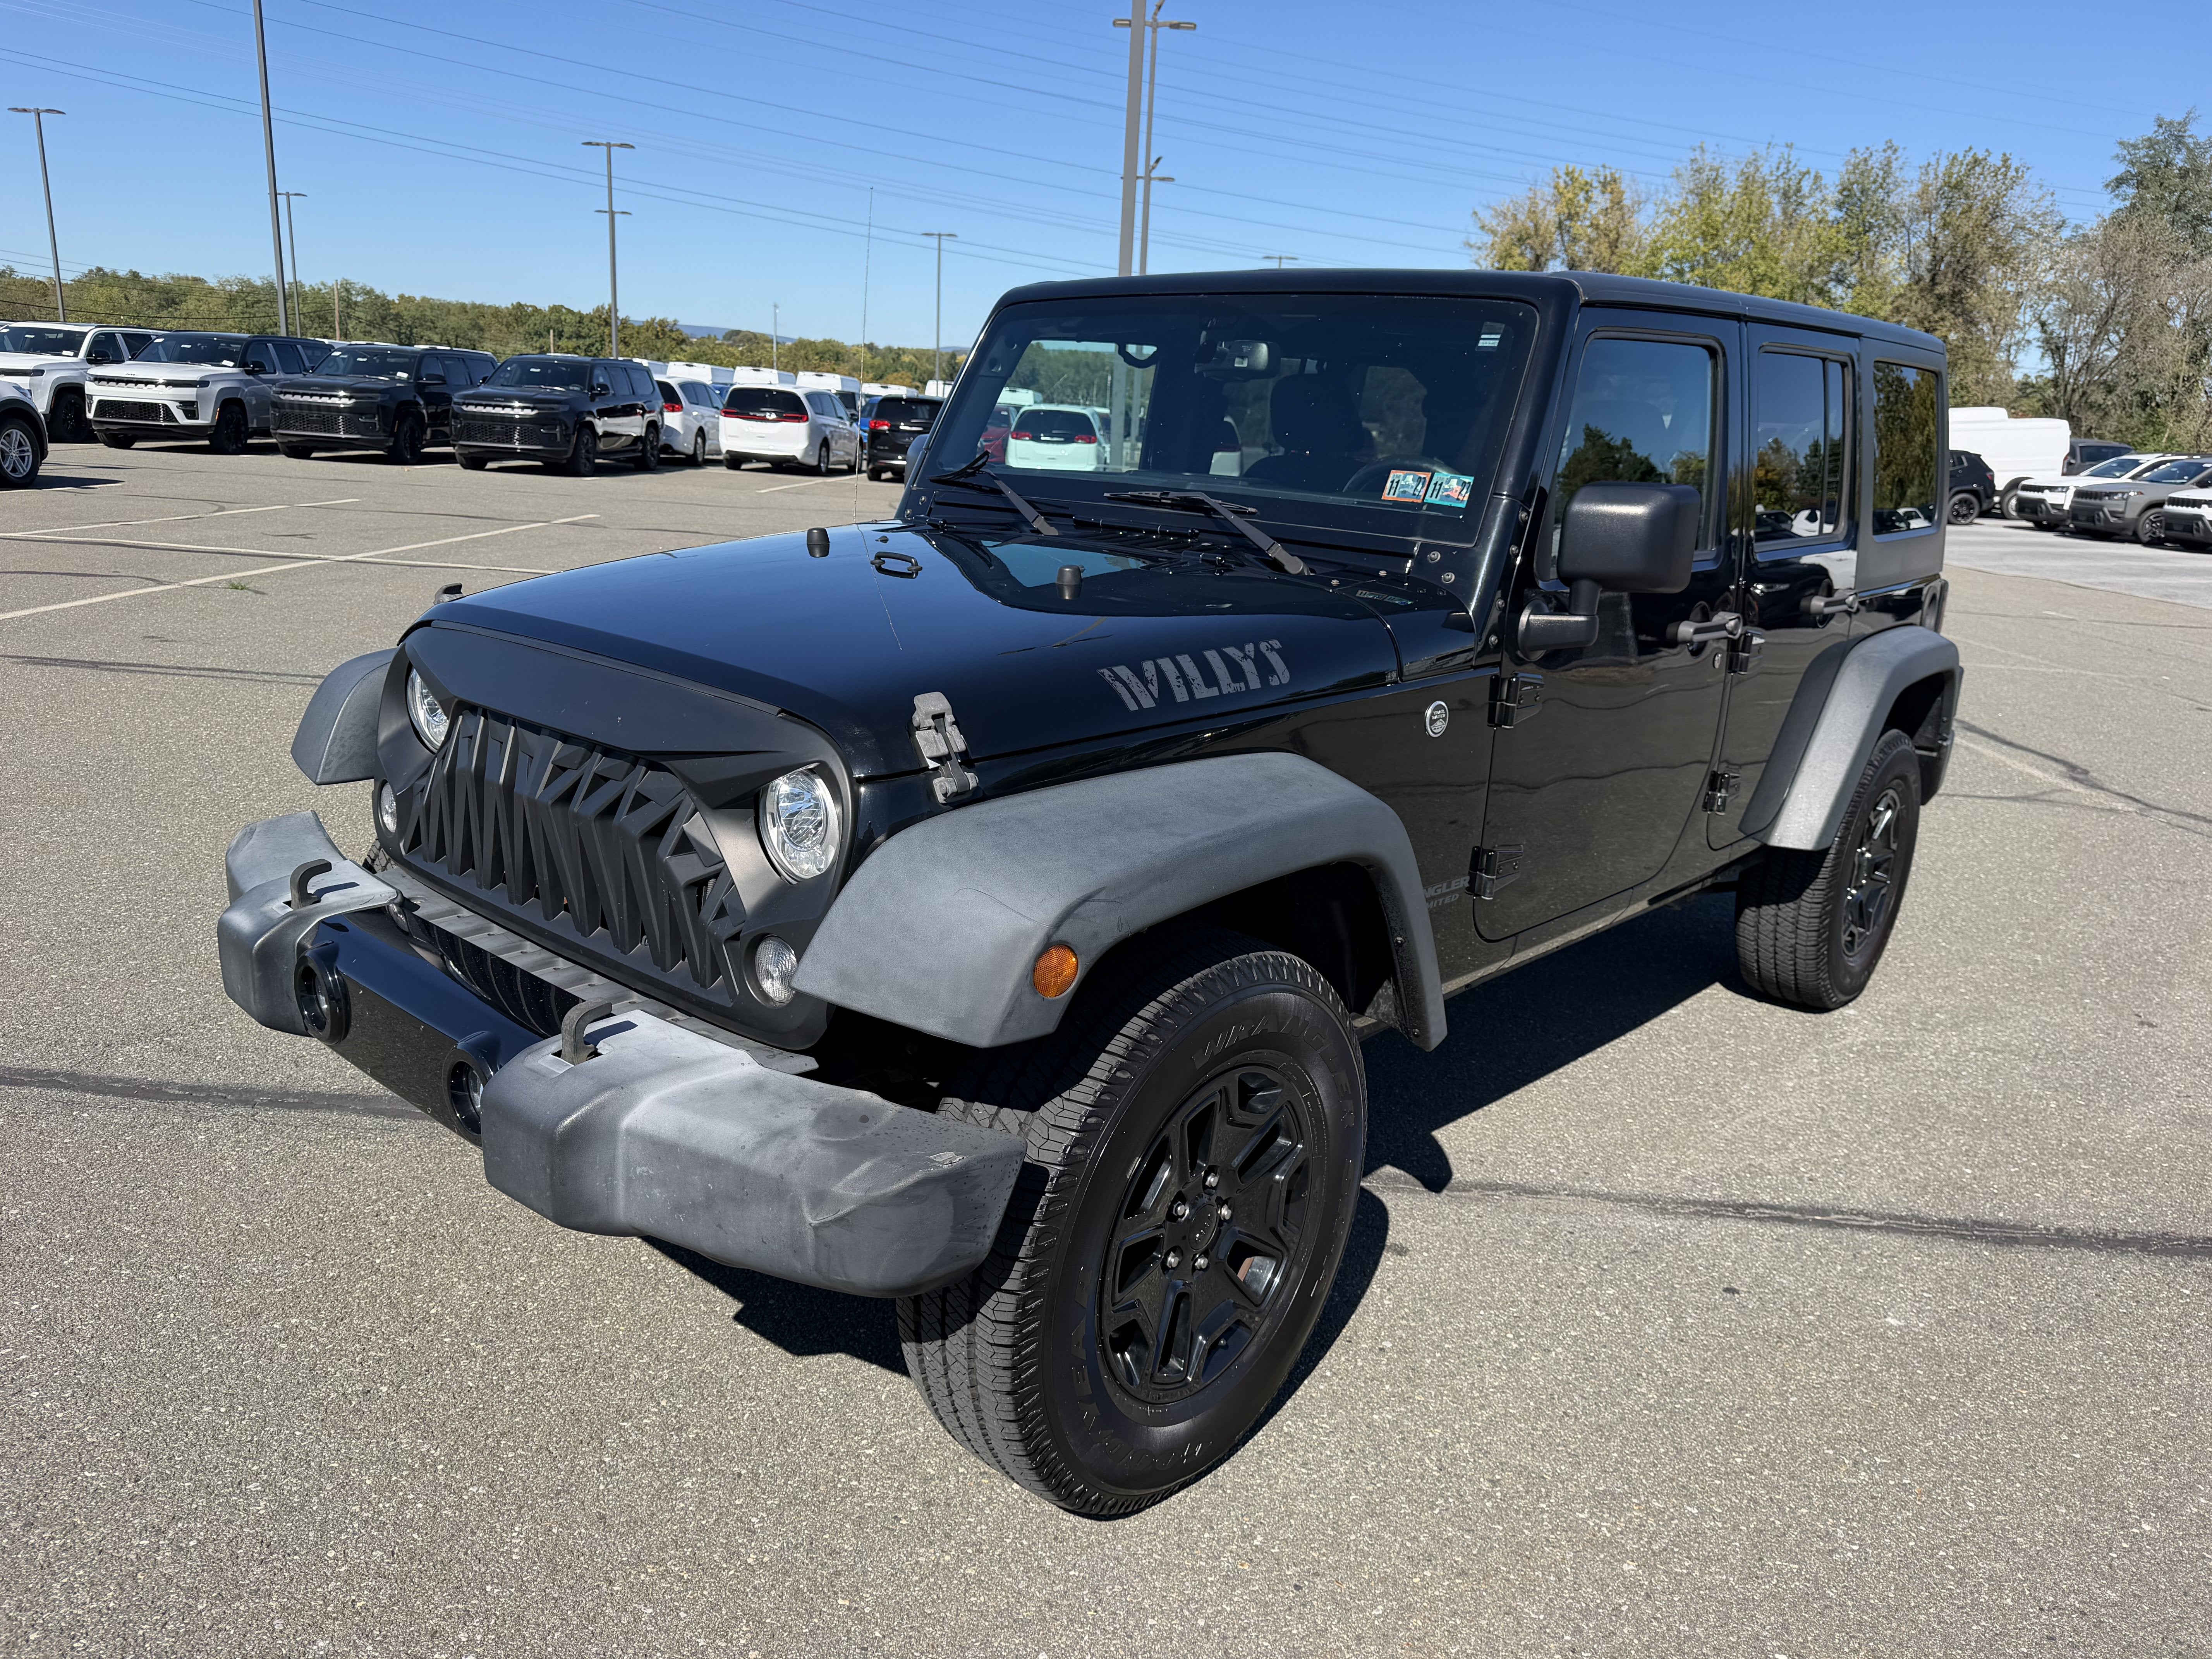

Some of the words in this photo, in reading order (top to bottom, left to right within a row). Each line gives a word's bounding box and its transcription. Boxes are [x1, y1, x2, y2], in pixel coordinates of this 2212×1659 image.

[1387, 479, 1400, 496] 11
[1430, 481, 1443, 499] 11
[1097, 639, 1290, 711] WILLYS
[1424, 876, 1470, 898] NGLER
[1426, 893, 1459, 909] MITED
